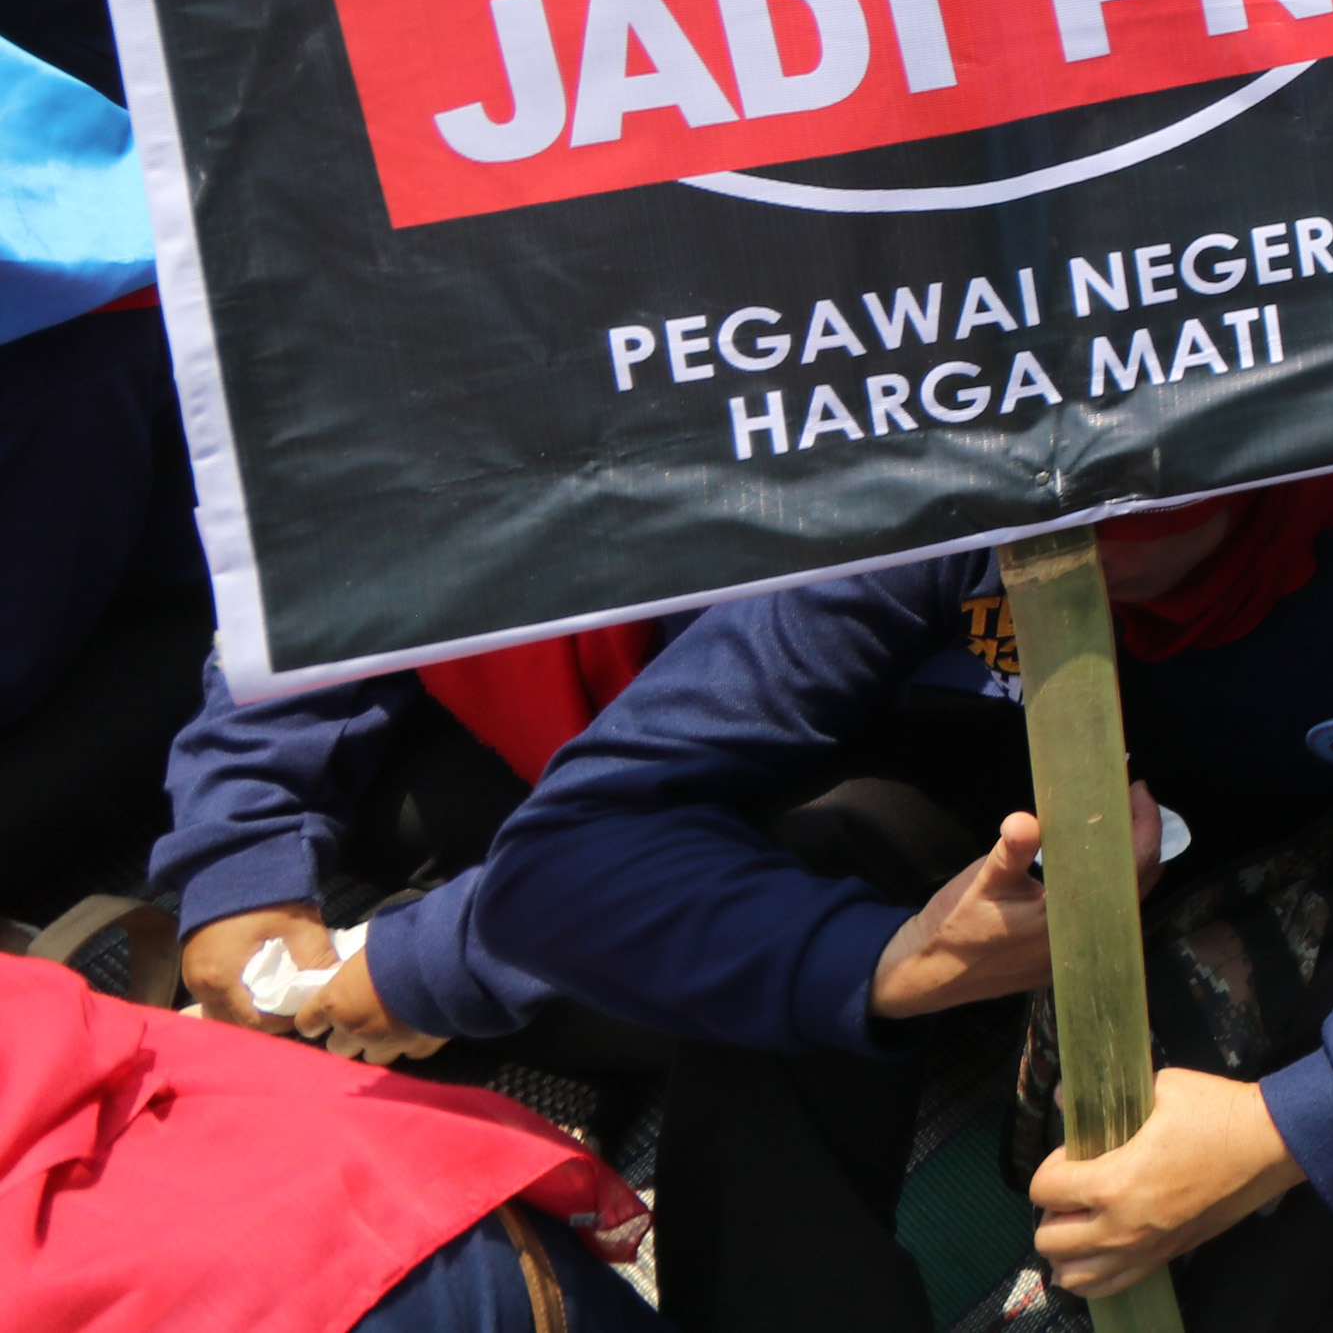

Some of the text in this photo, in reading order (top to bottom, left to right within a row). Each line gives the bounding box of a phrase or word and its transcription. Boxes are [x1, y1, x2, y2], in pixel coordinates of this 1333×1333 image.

[608, 267, 1040, 392] PEGAWAI
[729, 303, 1285, 461] HARGA MATI
